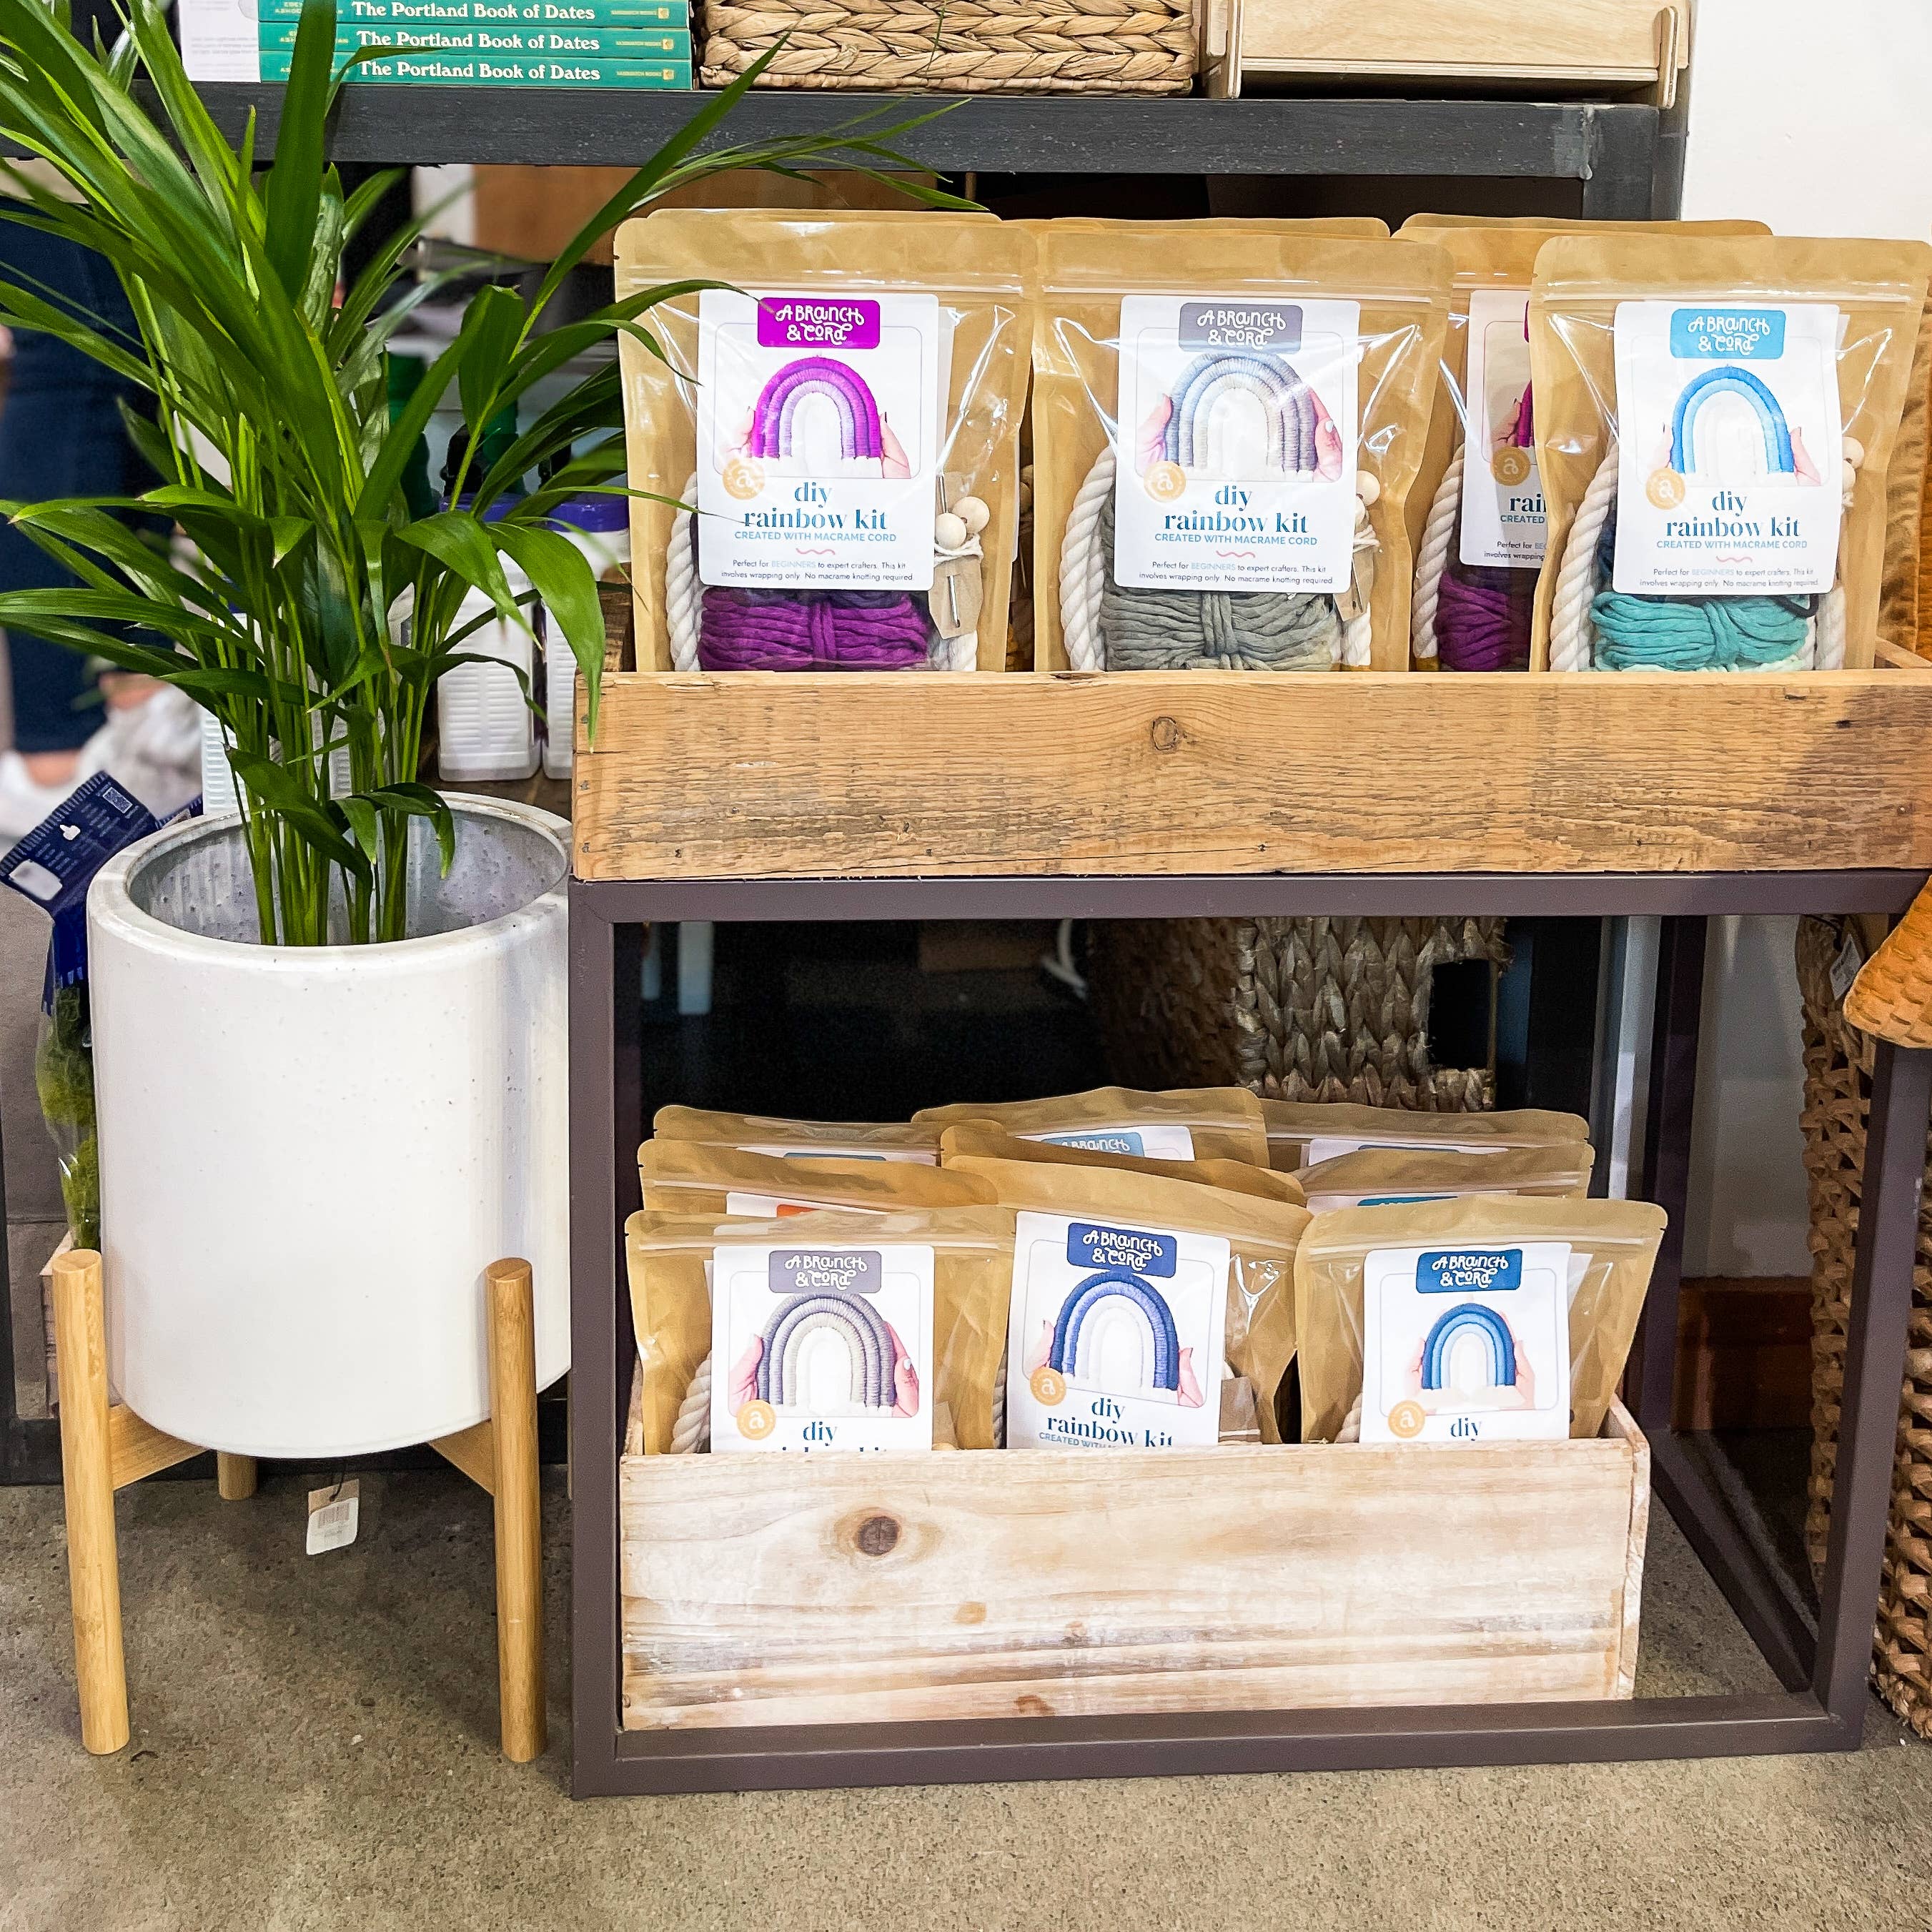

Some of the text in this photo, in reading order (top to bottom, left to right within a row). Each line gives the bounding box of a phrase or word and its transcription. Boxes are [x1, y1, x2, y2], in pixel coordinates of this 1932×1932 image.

[351, 1, 595, 19] The Portland Book of Dates
[357, 31, 600, 51] The Portland Book of Dates
[357, 60, 601, 80] The Portland Book of Dates
[775, 304, 793, 322] A
[1197, 309, 1215, 327] A
[1688, 316, 1705, 332] A
[787, 325, 801, 342] &
[1207, 329, 1222, 346] &
[1698, 335, 1712, 352] &
[794, 482, 832, 508] diy
[1214, 485, 1252, 511] diy
[1712, 491, 1747, 516] diy
[744, 507, 887, 530] rainbow kit
[1164, 510, 1309, 533] rainbow kit
[1500, 515, 1545, 524] CREATED
[1666, 517, 1801, 537] rainbow kit
[734, 531, 896, 542] CREATED WITH MACRAME CORD
[1155, 533, 1317, 545] CREATED WITH MACRAME CORD
[1656, 540, 1808, 549] CREATED WITH MACRAME CORD
[827, 562, 849, 570] expert
[1514, 553, 1545, 562] wrapping
[853, 572, 880, 582] knotting
[1169, 574, 1202, 583] wrapping
[1272, 575, 1300, 585] knotting
[1670, 580, 1702, 588] wrapping
[1083, 1230, 1099, 1244] A
[785, 1255, 801, 1269] A
[1092, 1247, 1106, 1264] &
[1432, 1256, 1448, 1271] A
[795, 1271, 809, 1287] &
[1440, 1272, 1454, 1287] &
[1091, 1397, 1126, 1424] diy
[803, 1421, 838, 1447] diy
[1048, 1417, 1173, 1447] rainbow kit
[1450, 1417, 1482, 1442] diy
[1039, 1432, 1079, 1446] CREATED
